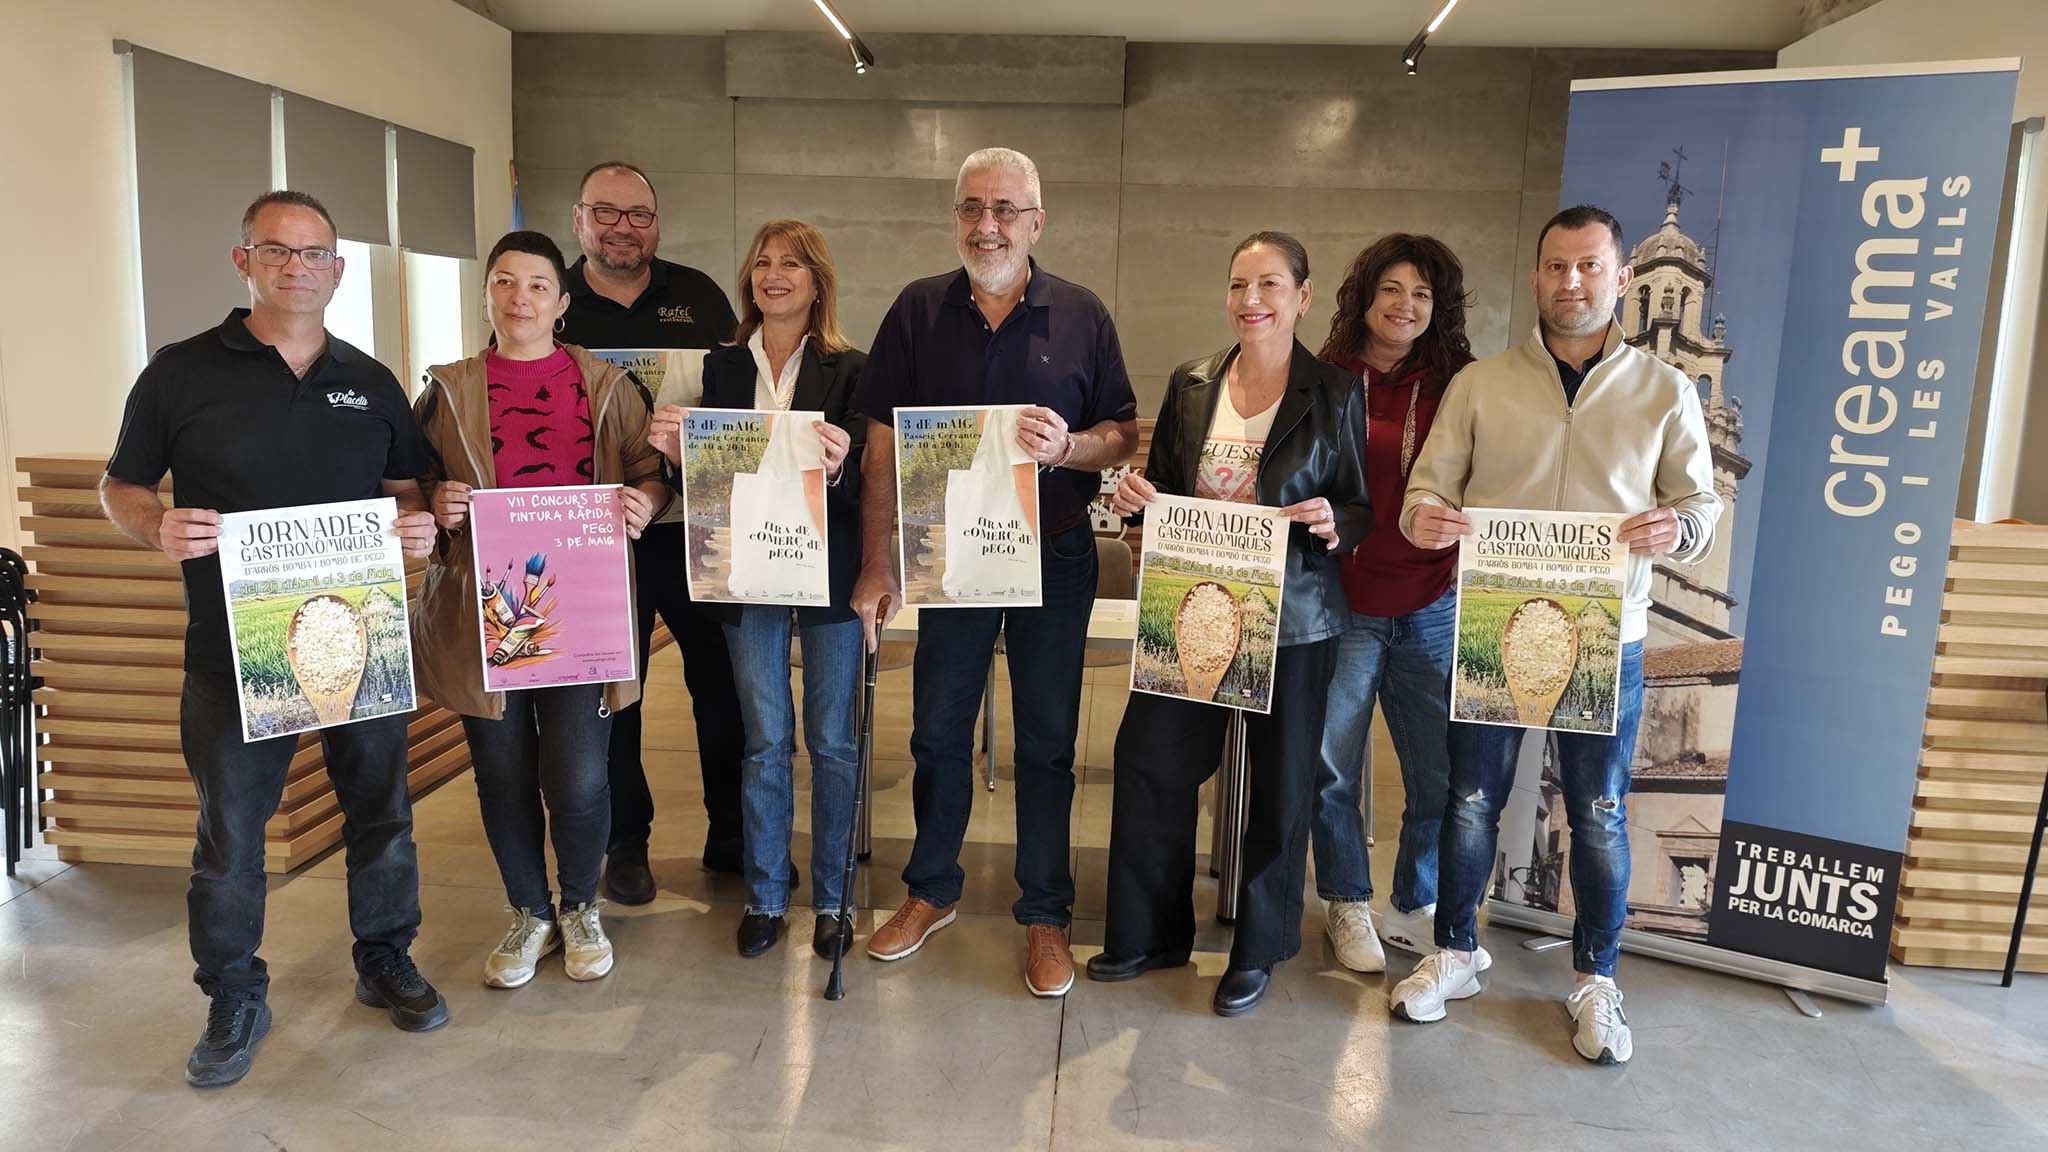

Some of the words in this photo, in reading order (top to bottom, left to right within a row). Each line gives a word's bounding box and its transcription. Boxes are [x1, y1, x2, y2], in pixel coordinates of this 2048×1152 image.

[1925, 174, 1972, 321] VALLS
[657, 305, 691, 318] Rafel
[1909, 358, 1946, 440] LES
[688, 419, 696, 430] 3
[904, 419, 911, 430] 3
[688, 432, 721, 442] Passeig
[724, 434, 770, 444] Cervantes
[904, 432, 935, 441] Passeig
[938, 432, 982, 441] Cervantes
[918, 441, 929, 449] 10
[940, 441, 952, 449] 20
[688, 442, 700, 450] de
[703, 442, 714, 450] 10
[726, 443, 738, 451] 20
[1201, 442, 1264, 460] GUESS
[1901, 475, 1930, 486] I
[506, 495, 525, 508] VII
[531, 493, 588, 507] CONCURS
[594, 492, 612, 504] DE
[510, 510, 562, 523] PINTURA
[568, 504, 613, 520] RÀPIDA
[1160, 506, 1273, 538] JORNADES
[241, 512, 380, 546] JORNADES
[582, 523, 614, 535] PEGO
[1479, 519, 1612, 546] JORNADES
[241, 533, 383, 562] GASTRONÒMIQUES
[554, 538, 562, 548] 3
[568, 536, 583, 550] DE
[588, 536, 615, 546] MAIG
[1158, 525, 1272, 552] GASTRONÒMIQUES
[1186, 546, 1209, 557] BOMBA
[1241, 553, 1251, 562] DE
[1253, 555, 1271, 565] PEGO
[1477, 540, 1611, 562] GASTRONÒMIQUES
[283, 559, 311, 572] BOMBA
[351, 554, 362, 564] DE
[364, 552, 385, 562] PEGO
[1226, 564, 1233, 576] 3
[1236, 567, 1249, 577] de
[1512, 561, 1538, 570] BOMBA
[1576, 565, 1587, 573] DE
[1589, 565, 1611, 575] PEGO
[336, 572, 345, 584] 3
[351, 570, 363, 581] de
[367, 567, 394, 582] Maig
[1880, 521, 1922, 638] PEGO
[1559, 579, 1567, 590] 3
[1571, 580, 1585, 591] de
[1735, 840, 1885, 883] TREBALLEM
[1729, 858, 1880, 921] JUNTS
[1728, 896, 1760, 916] PER
[1763, 903, 1784, 921] LA
[1787, 908, 1874, 939] COMARCA
